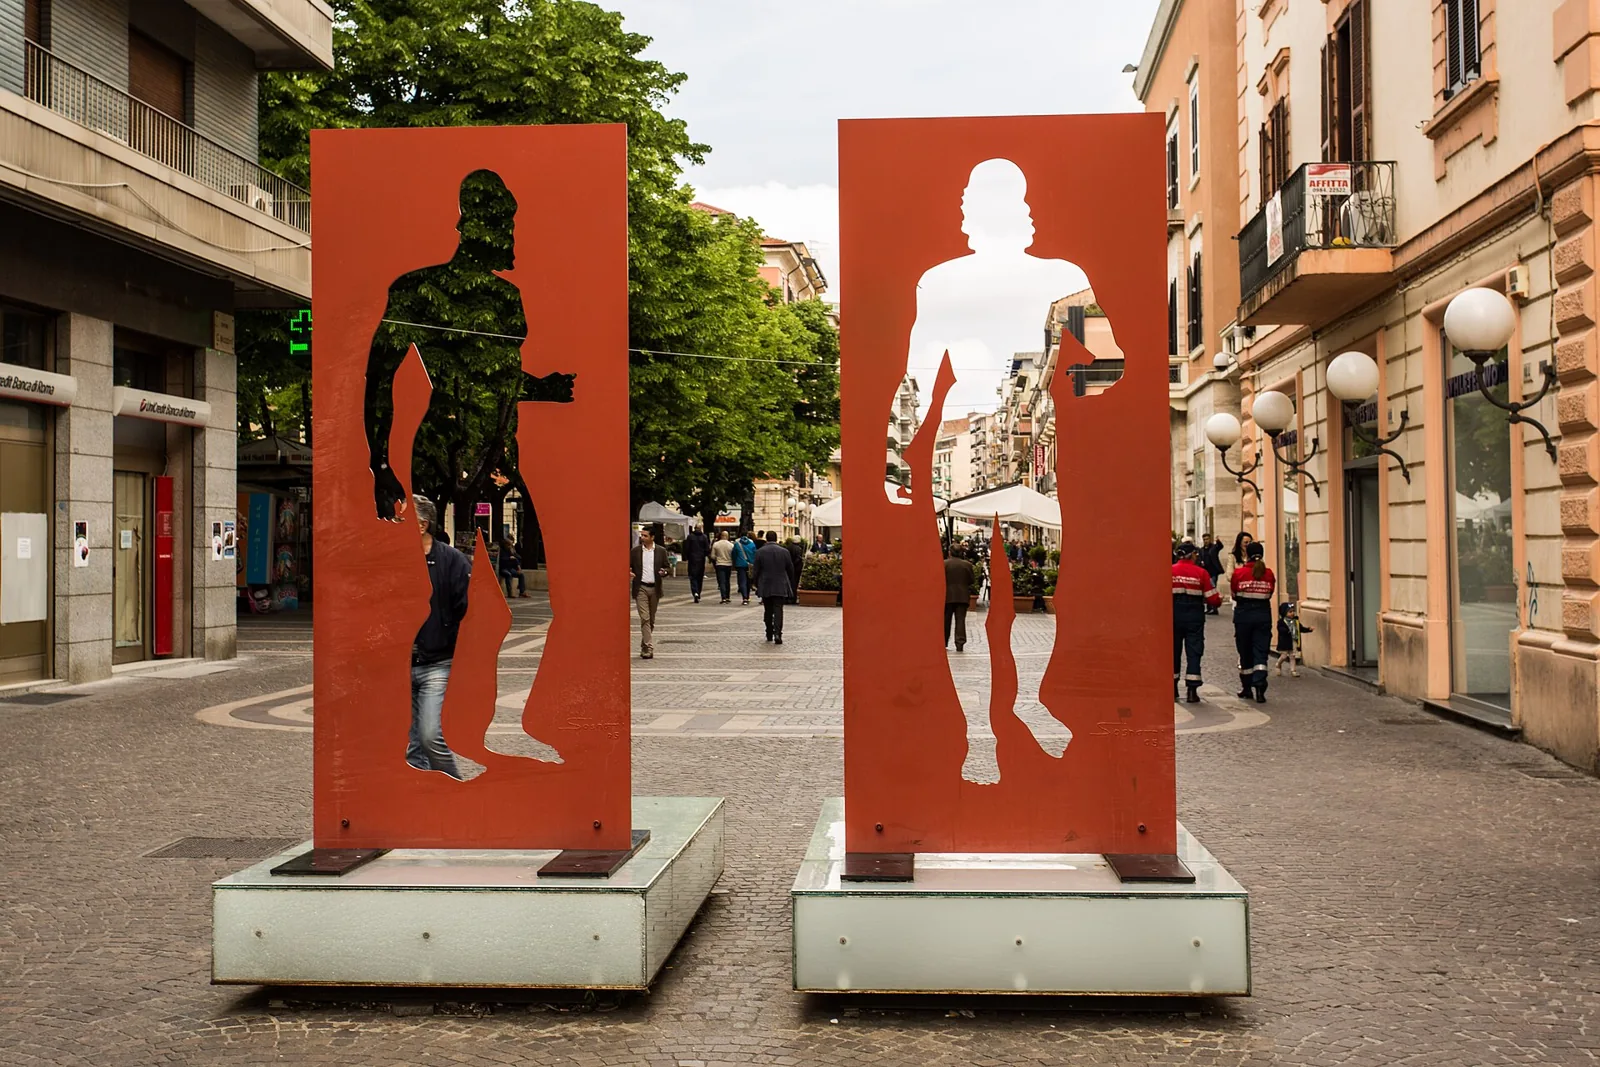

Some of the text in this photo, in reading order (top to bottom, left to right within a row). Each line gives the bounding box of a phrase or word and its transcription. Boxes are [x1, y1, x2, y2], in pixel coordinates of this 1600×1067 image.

[12, 376, 32, 392] Banca
[31, 380, 38, 392] di
[37, 380, 55, 395] Roma
[146, 401, 167, 414] UniCredit
[166, 404, 180, 416] Banca
[184, 406, 197, 419] Roma
